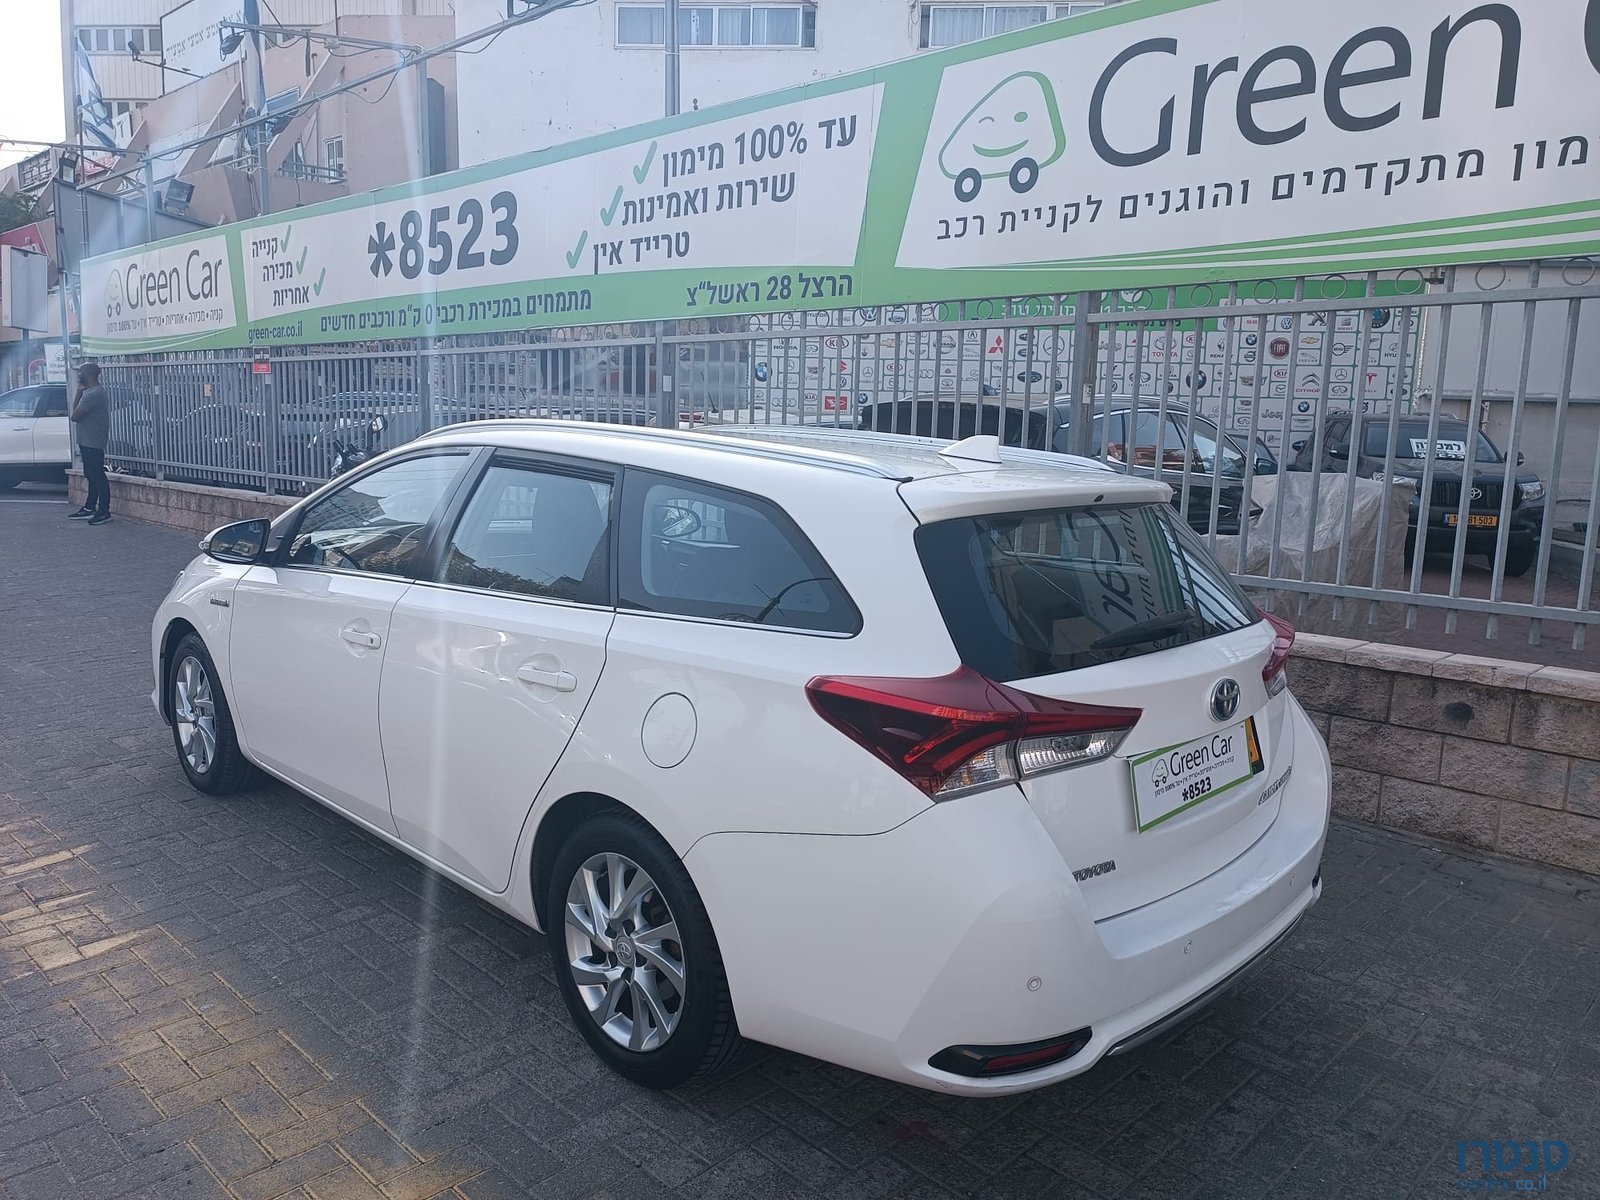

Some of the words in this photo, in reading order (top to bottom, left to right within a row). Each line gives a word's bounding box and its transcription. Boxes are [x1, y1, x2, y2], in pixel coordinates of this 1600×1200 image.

[1088, 3, 1521, 167] Green
[735, 121, 807, 166] 100%
[818, 114, 857, 149] עד
[663, 141, 724, 187] מימון
[1271, 149, 1485, 201] מתקדמים
[716, 171, 795, 211] שירות
[1119, 179, 1250, 219] והוגנים
[622, 186, 708, 226] ואמינות
[997, 194, 1102, 233] לקניית
[937, 214, 985, 240] רכב
[252, 237, 278, 260] קנייה
[593, 240, 623, 275] אין
[630, 230, 690, 263] טרייד
[126, 263, 181, 310] Green
[186, 249, 222, 300] Car
[263, 261, 293, 282] מכירה
[273, 286, 310, 307] אחריות
[766, 275, 792, 301] 28
[798, 272, 853, 299] הרצל
[425, 303, 433, 325] 0
[437, 303, 464, 324] רכבי
[468, 297, 521, 321] במכירת
[527, 289, 592, 315] מתמחים
[249, 320, 303, 343] green-car.co.il
[320, 314, 355, 332] חדשים
[360, 310, 395, 329] ורכבים
[1273, 344, 1286, 353] FIAT
[1170, 746, 1209, 776] Green
[1211, 735, 1232, 758] Car
[1072, 860, 1116, 882] TOYOTA
